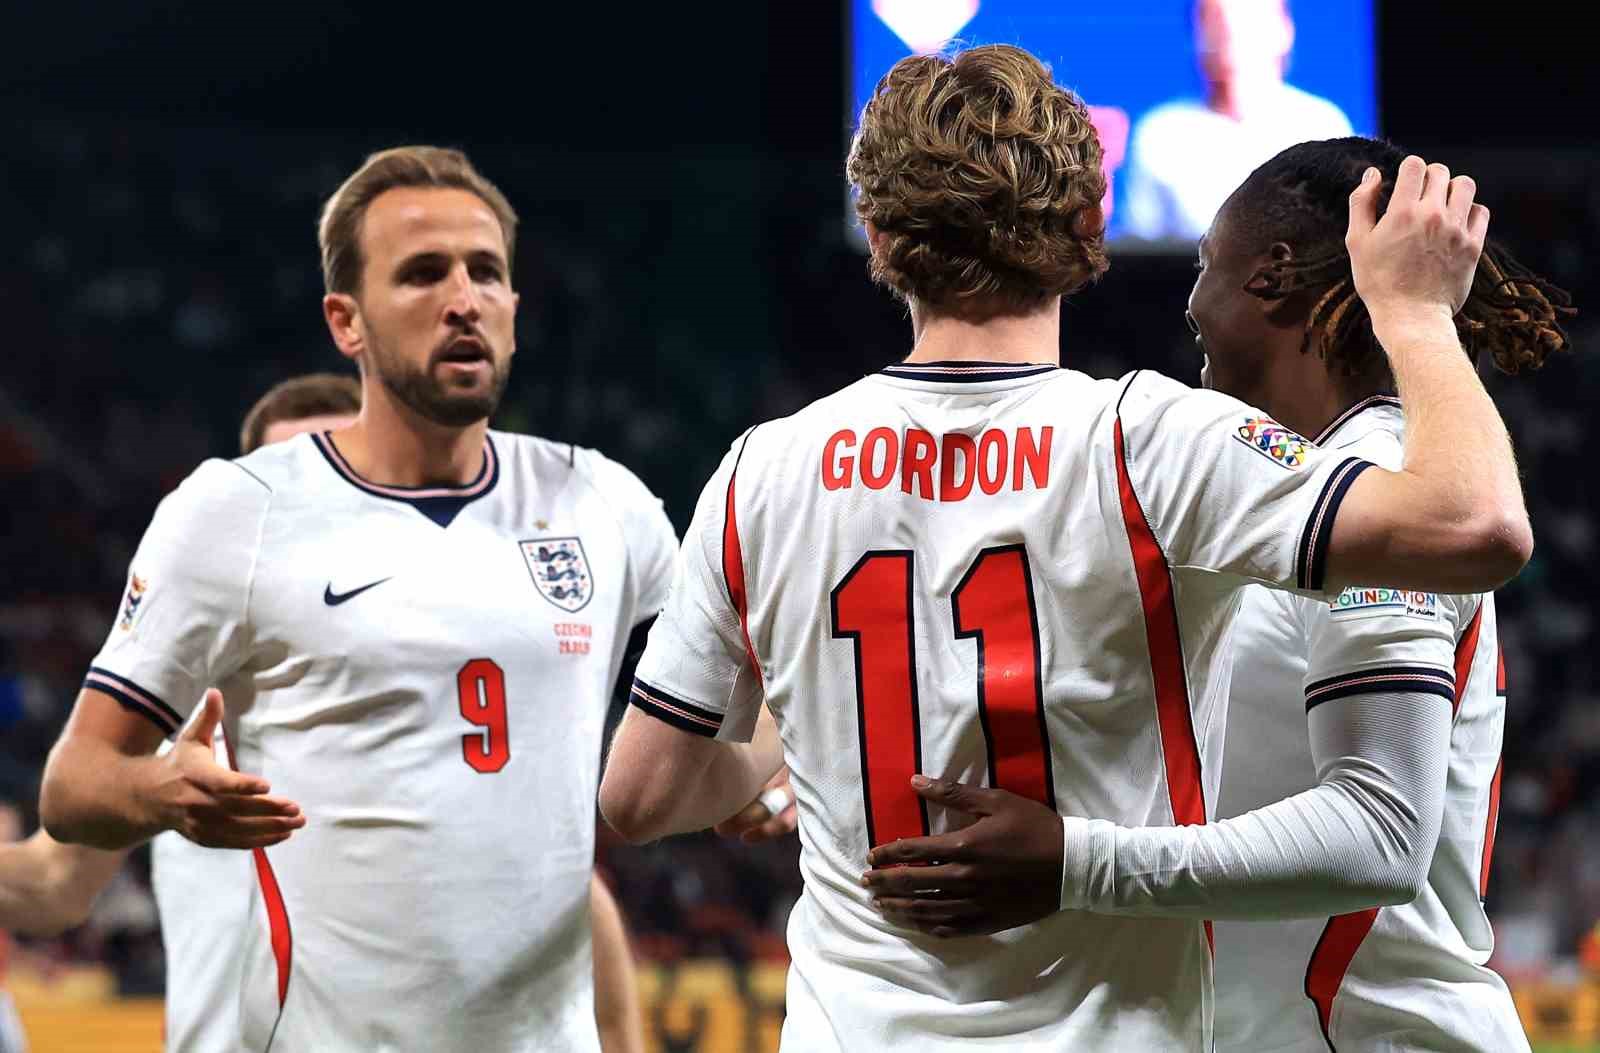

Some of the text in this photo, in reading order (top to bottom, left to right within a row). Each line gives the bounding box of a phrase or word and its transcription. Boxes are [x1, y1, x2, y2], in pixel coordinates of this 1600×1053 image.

[822, 426, 1053, 502] GORDON
[456, 658, 510, 774] 9
[830, 543, 1057, 868] 11
